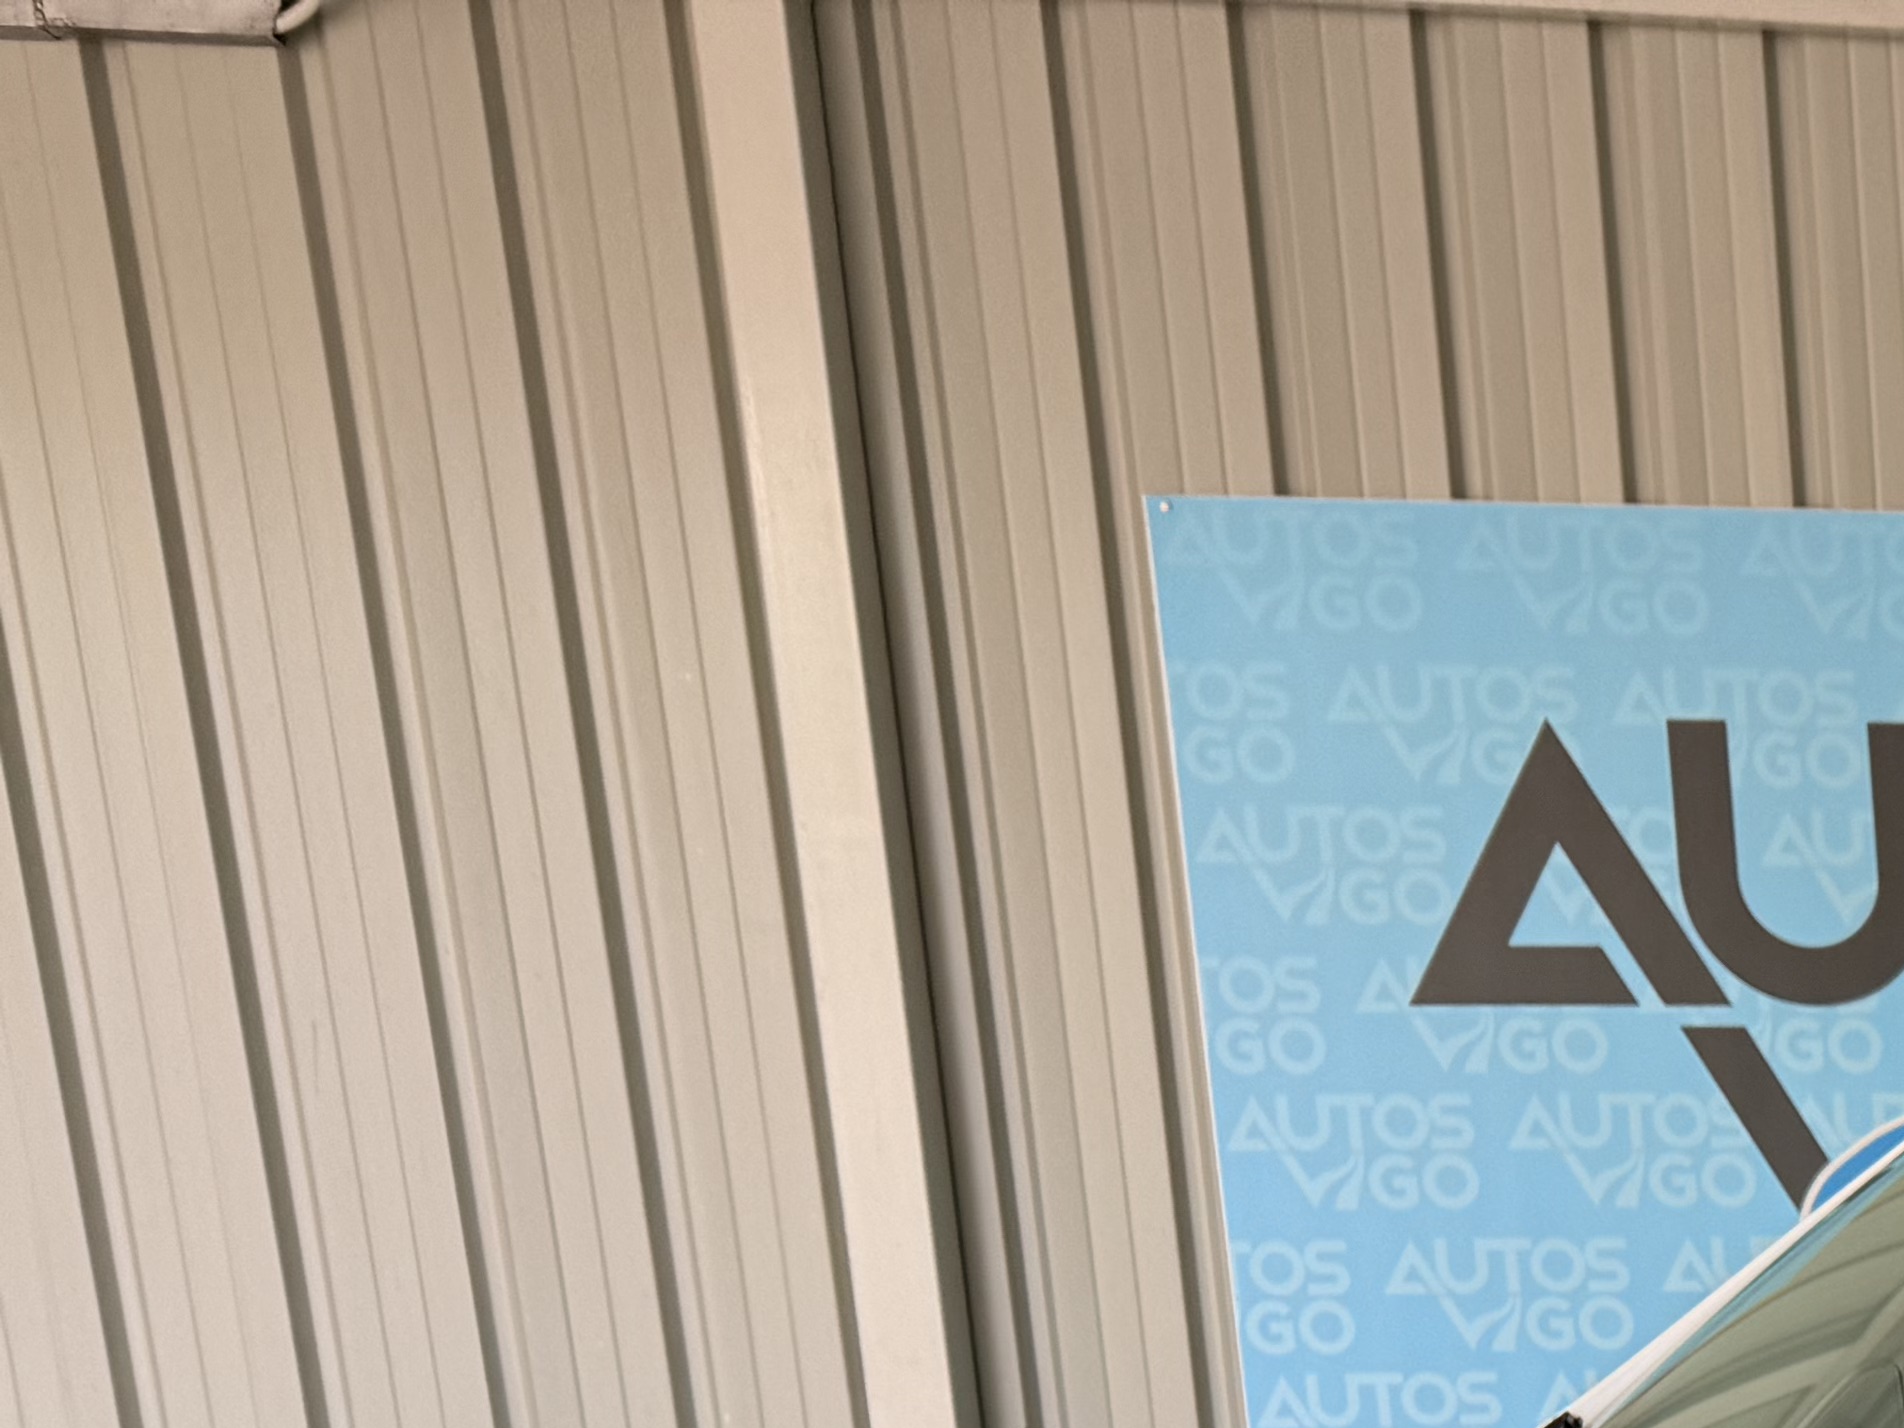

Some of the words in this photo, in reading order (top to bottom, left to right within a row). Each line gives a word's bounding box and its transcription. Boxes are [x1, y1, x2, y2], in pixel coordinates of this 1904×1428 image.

[1162, 508, 1420, 568] AUTOS
[1453, 511, 1705, 574] AUTOS
[1220, 570, 1425, 633] VIGO
[1513, 575, 1709, 638] VIGO
[1326, 660, 1580, 726] AUTOS
[1610, 666, 1859, 728] AUTOS
[1384, 726, 1583, 787] VIG
[1196, 805, 1448, 864] AUTOS
[1253, 866, 1453, 927] VIGO
[1226, 1092, 1475, 1152] AUTOS
[1280, 1151, 1480, 1212] VIGO
[1564, 1150, 1757, 1209] VIGO
[1385, 1236, 1632, 1296] AUTOS
[1440, 1296, 1635, 1352] VIGO
